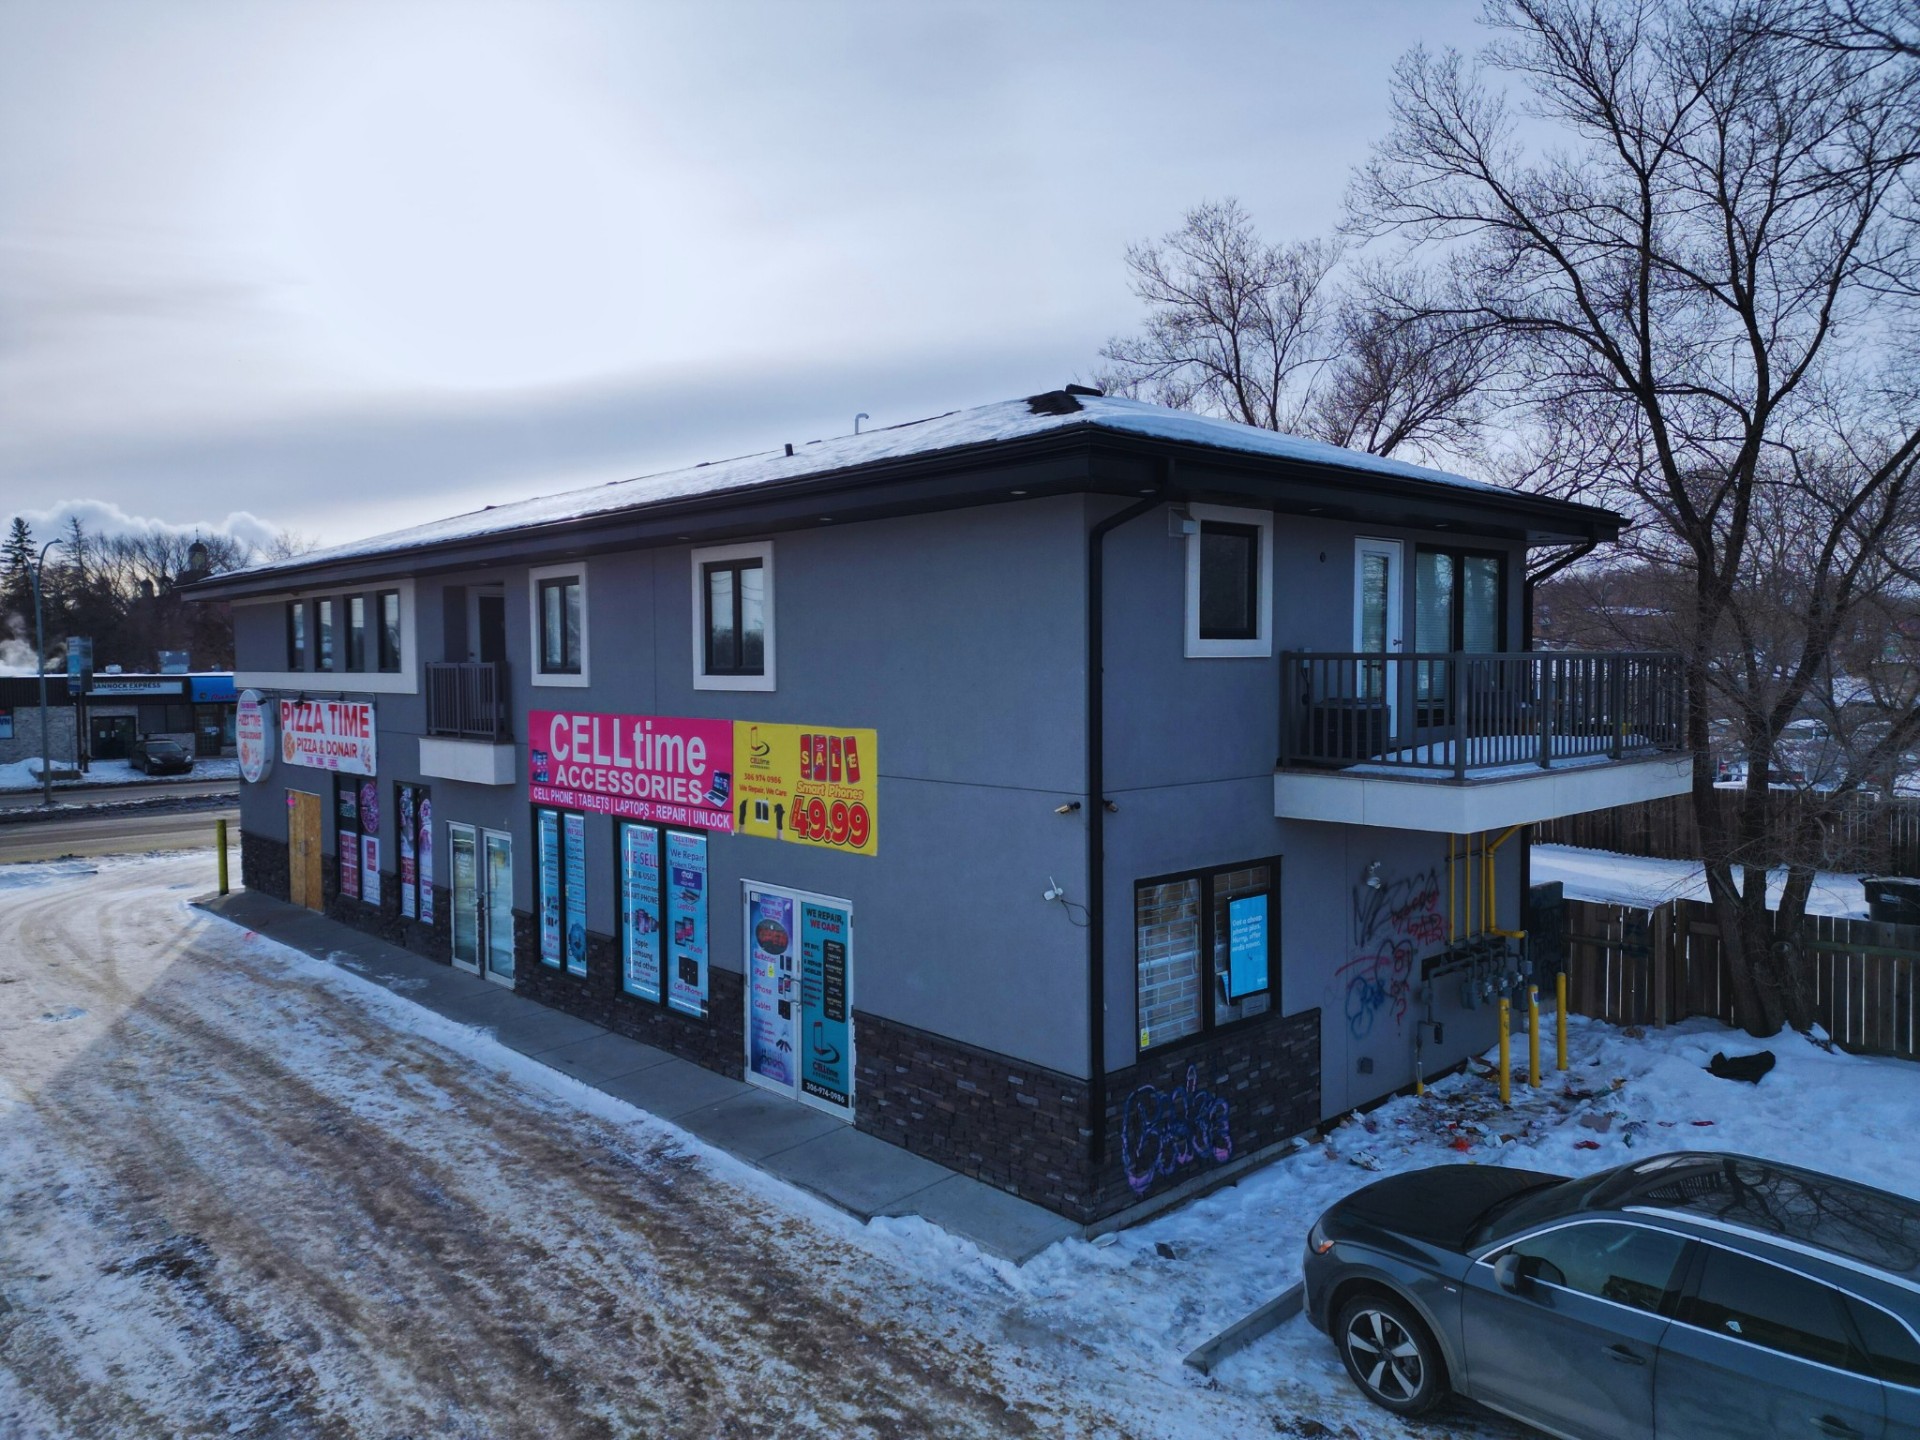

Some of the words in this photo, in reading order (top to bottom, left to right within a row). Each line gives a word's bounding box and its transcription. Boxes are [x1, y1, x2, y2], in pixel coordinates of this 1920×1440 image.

[129, 681, 161, 689] EXPRESS
[281, 701, 325, 734] PIZZA
[328, 703, 370, 738] TIME
[297, 737, 318, 754] PIZZA
[326, 740, 358, 758] DONAIR
[550, 713, 706, 776] CELLtime
[555, 764, 703, 804] ACCESSORIES
[755, 774, 766, 782] 974
[766, 787, 774, 795] We
[774, 788, 787, 796] Care
[797, 780, 826, 796] Smart
[828, 783, 864, 801] Phones
[533, 787, 550, 801] CELL
[551, 789, 573, 804] PHONE
[578, 793, 610, 811] TABLETS
[615, 798, 649, 817] LAPTOPS
[656, 804, 686, 822] REPAIR
[693, 809, 730, 829] UNLOCK
[791, 795, 870, 849] 49.99
[640, 851, 658, 868] SELL
[671, 849, 681, 858] We
[683, 851, 704, 862] Repair
[806, 908, 817, 918] WE
[818, 910, 844, 925] REPAIR,
[810, 919, 821, 929] WE
[754, 1000, 771, 1011] Cables
[806, 1082, 845, 1104] 306-974-0986
